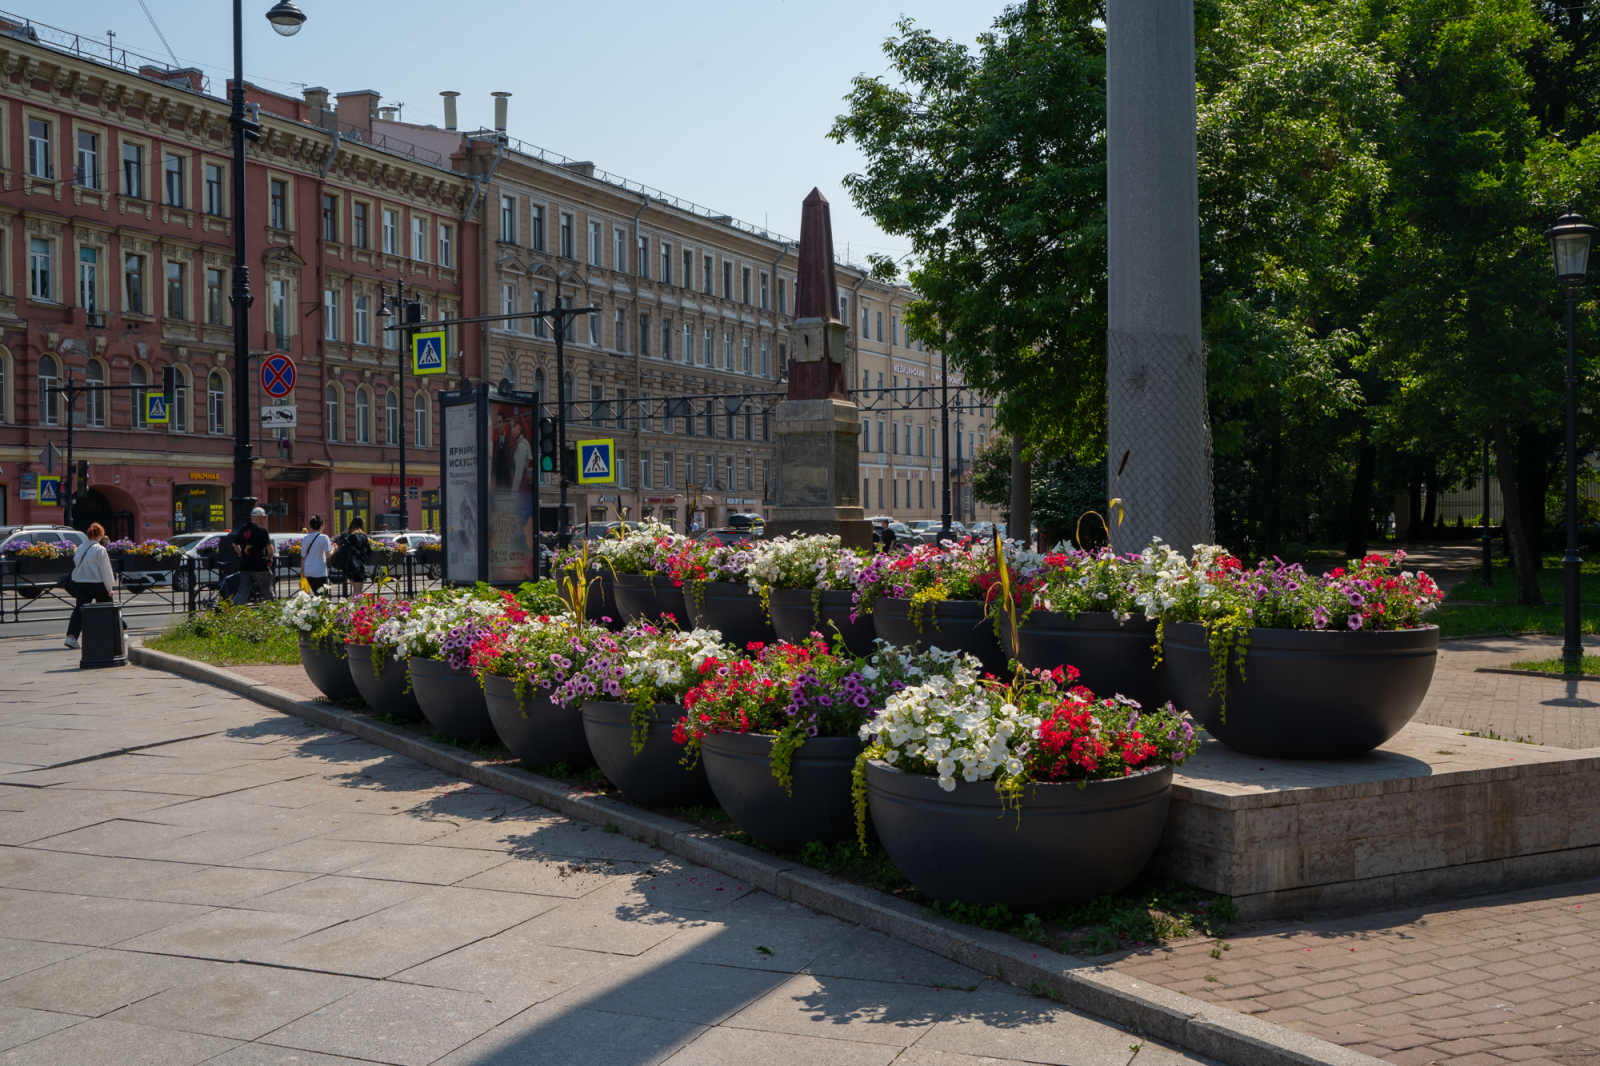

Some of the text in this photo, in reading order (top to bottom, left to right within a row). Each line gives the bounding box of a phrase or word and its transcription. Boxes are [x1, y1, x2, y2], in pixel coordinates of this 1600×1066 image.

[893, 364, 924, 378] МЕДИЦИНСКИЙ
[392, 476, 415, 486] МАКЕТ
[415, 477, 424, 486] 24
[343, 493, 353, 502] 24
[490, 549, 498, 563] 24
